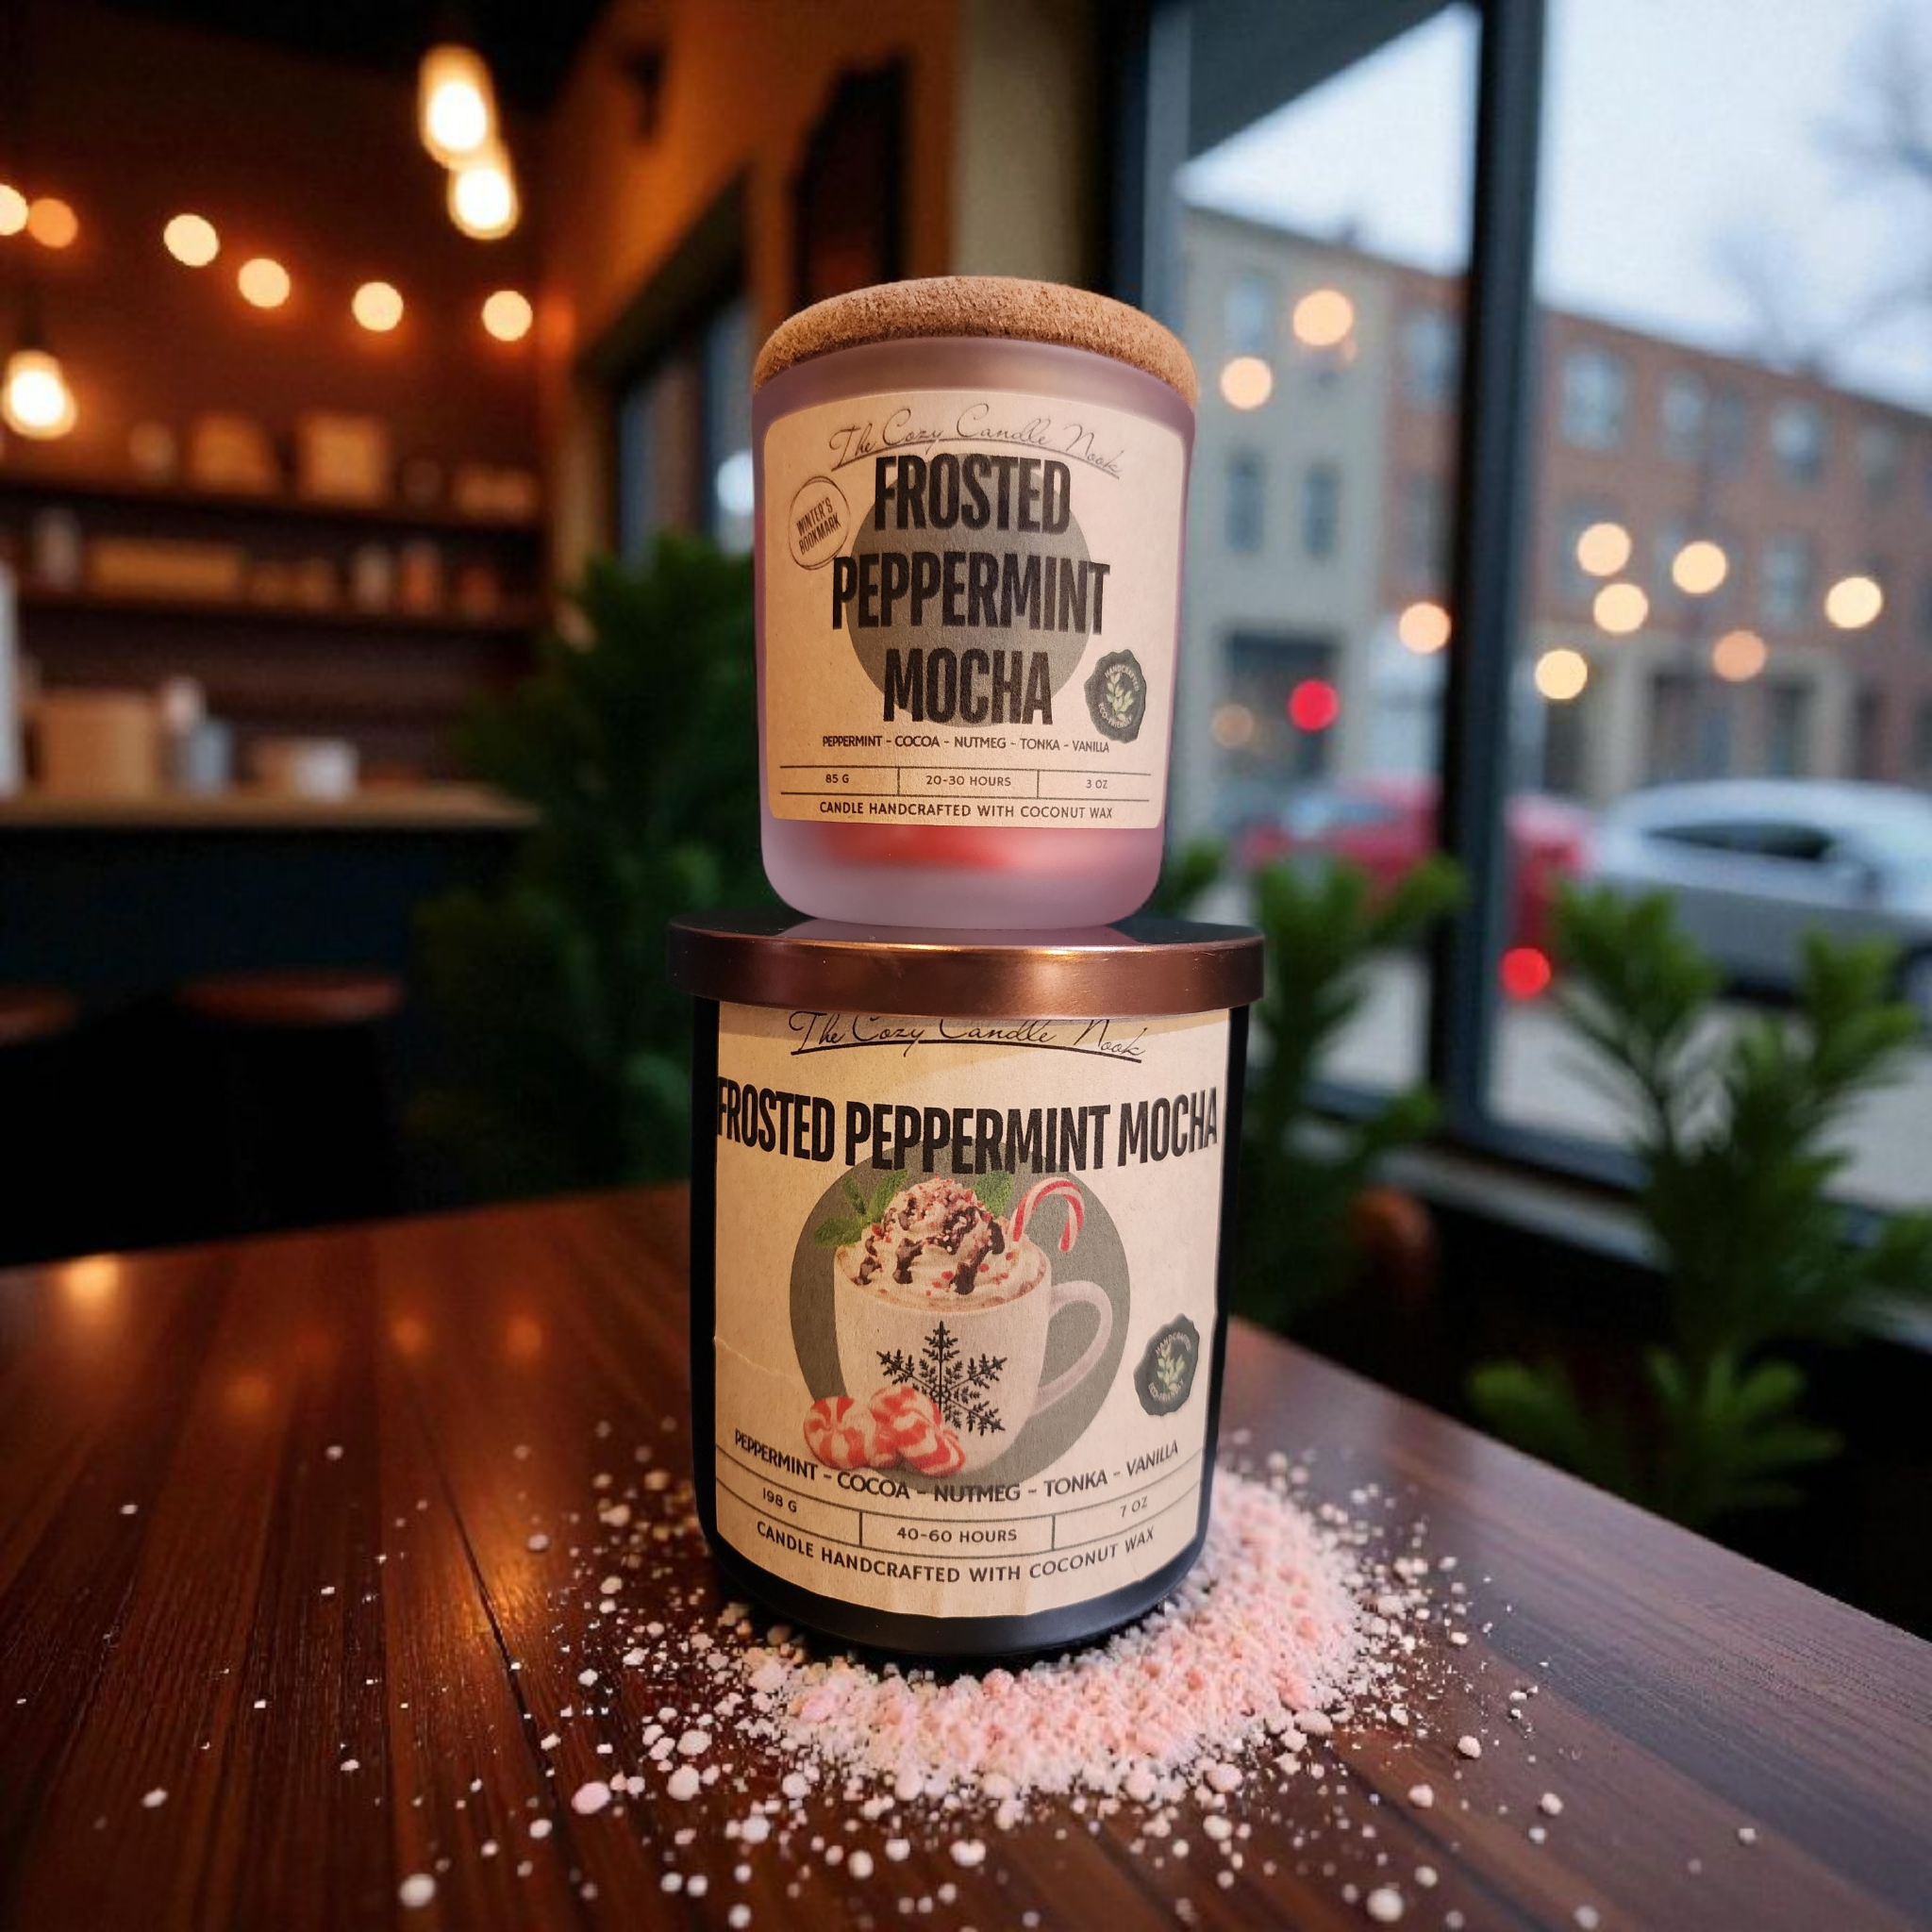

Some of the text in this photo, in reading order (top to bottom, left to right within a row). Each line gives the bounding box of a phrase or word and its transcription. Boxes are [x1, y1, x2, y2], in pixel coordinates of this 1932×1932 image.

[828, 402, 1124, 473] The Cozy Candle Nook
[874, 453, 1071, 536] FROSTED
[796, 496, 833, 537] WINTER'S
[798, 512, 841, 556] BOOKMARK
[832, 551, 1111, 636] PEPPERMINT
[883, 646, 1054, 725] MOCHA
[822, 735, 883, 748] PEPPERMINT
[894, 735, 941, 748] COCOA
[954, 736, 1007, 749] NUTMEG
[1020, 738, 1060, 751] TONKA
[1072, 740, 1109, 754] VANILLA
[824, 774, 850, 784] 85 G
[925, 774, 1011, 787] 20-30 HOURS
[1085, 779, 1108, 790] 3 OZ
[819, 801, 1113, 819] CANDLE HANDCRAFTED WITH COCONUT WAX
[788, 1010, 846, 1052] The
[717, 1075, 1218, 1175] FROSTED PEPPERMINT MOCHA
[735, 1428, 819, 1481] PEPPERMINT
[837, 1471, 911, 1500] COCOA
[934, 1483, 1021, 1503] NUTMEG
[1043, 1469, 1108, 1497] TONKA
[1125, 1439, 1179, 1477] VANILLA
[762, 1487, 798, 1513] 198 G
[1121, 1495, 1149, 1518] 7 OZ
[757, 1520, 1155, 1583] CANDLE HANDCRAFTED WITH COCONUT WAX
[896, 1526, 1018, 1543] 40-60 HOURS
